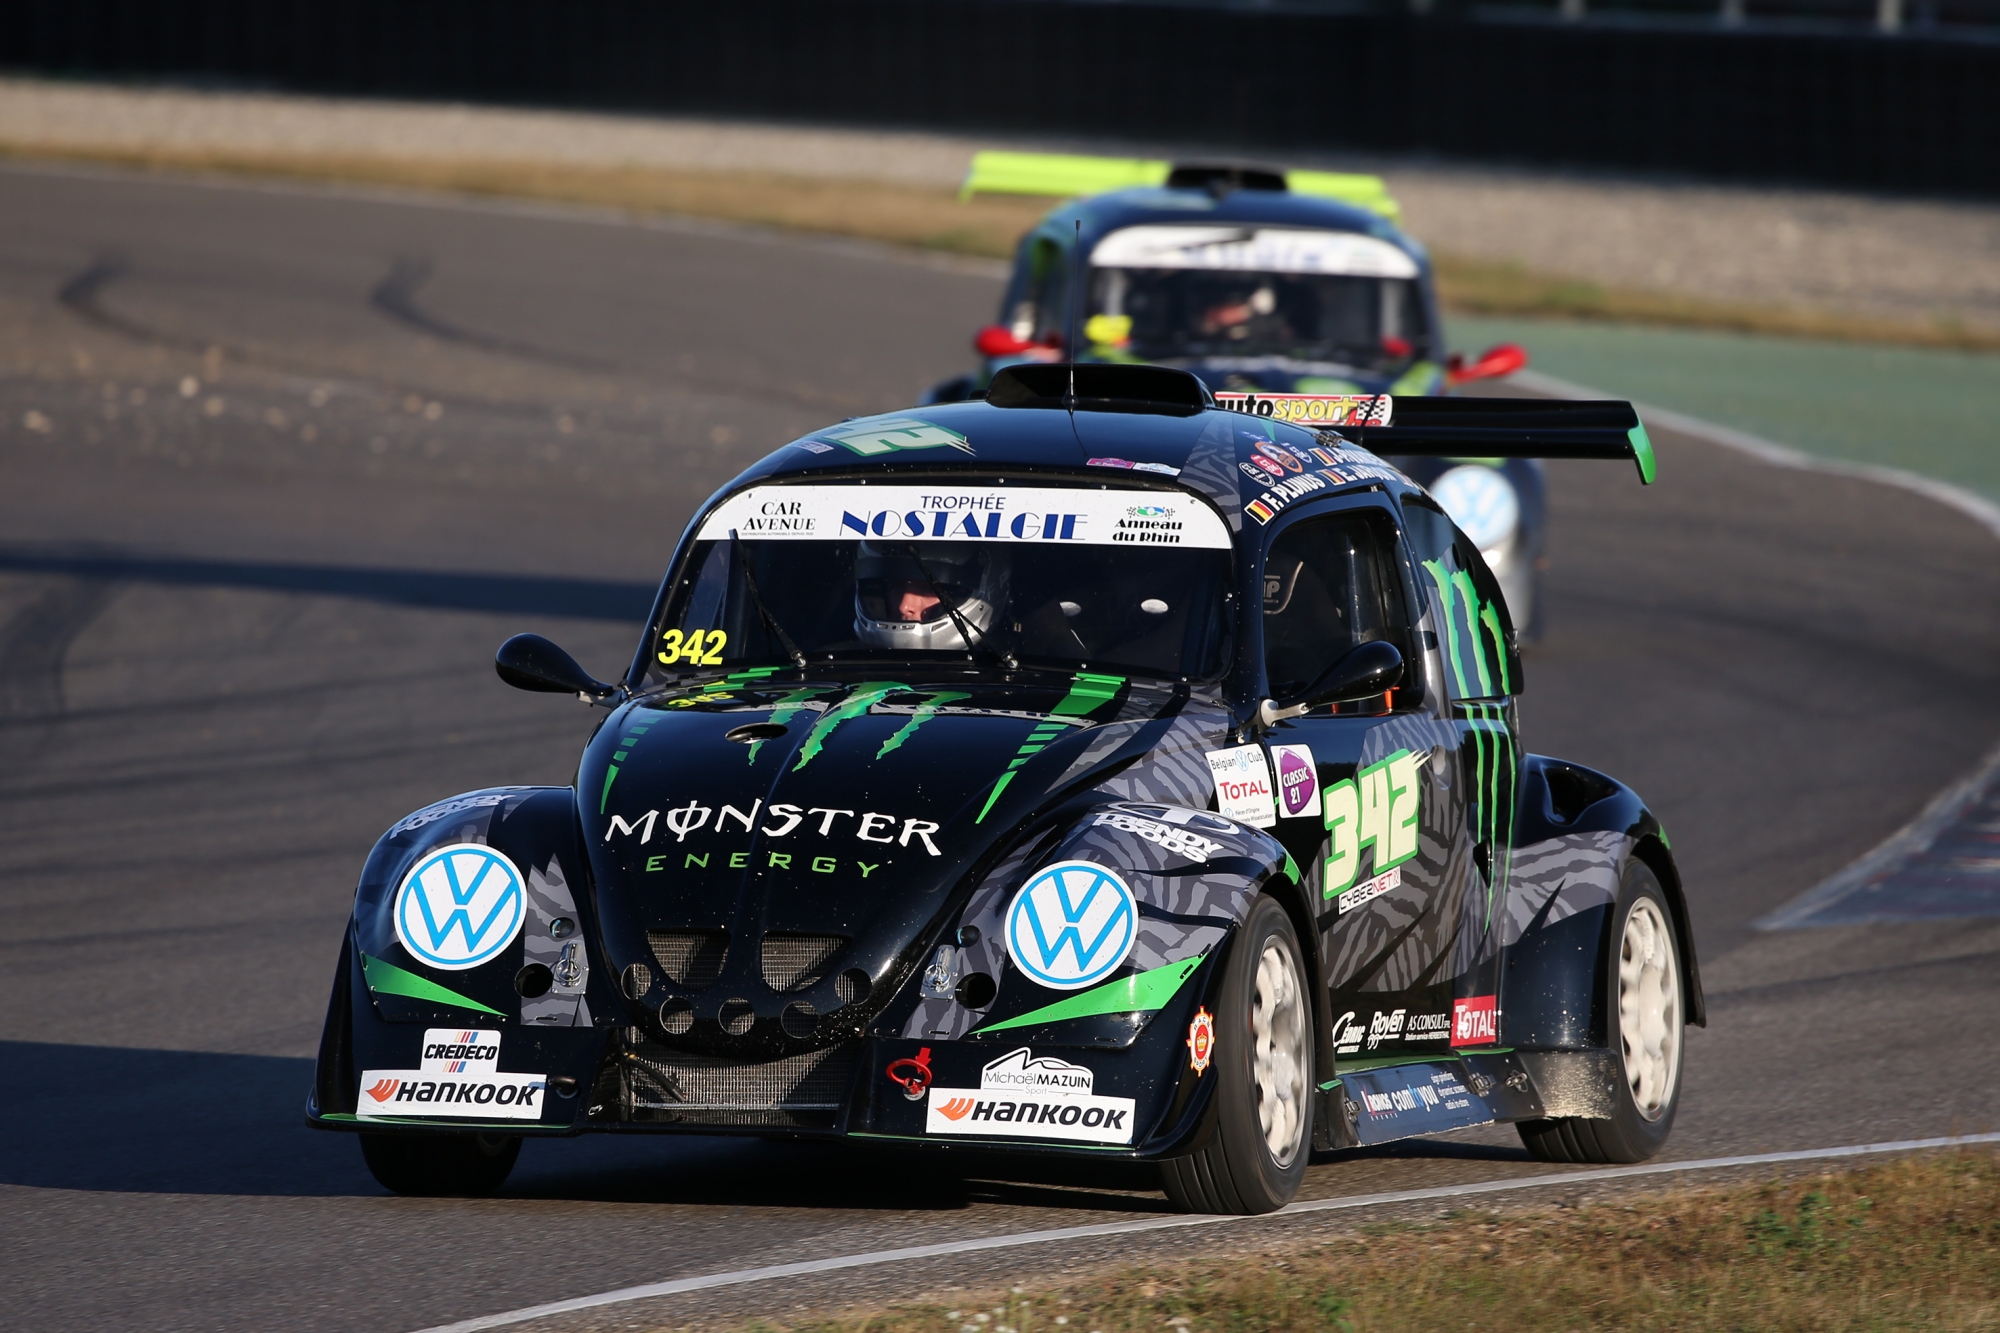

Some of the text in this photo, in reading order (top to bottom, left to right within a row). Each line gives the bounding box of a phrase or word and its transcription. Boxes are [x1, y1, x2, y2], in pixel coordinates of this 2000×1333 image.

[761, 501, 802, 516] CAR
[921, 493, 1006, 510] TROPHÉE
[743, 517, 816, 531] AVENUE
[839, 510, 1088, 540] NOSTALGIE
[1114, 518, 1182, 530] Anneau
[1112, 531, 1180, 543] du Rhin
[657, 629, 727, 665] 342
[1211, 758, 1237, 771] Belgian
[1247, 751, 1264, 763] Club
[1283, 767, 1309, 788] CLASSIC
[1219, 780, 1269, 800] TOTAL
[1290, 786, 1301, 805] 21
[1094, 813, 1224, 853] TRENDY
[1323, 748, 1424, 900] 342
[1092, 821, 1209, 863] FOODS
[646, 852, 879, 878] ENERGY
[1407, 1015, 1417, 1031] AS
[1417, 1013, 1446, 1030] CONSULT
[1455, 1004, 1496, 1040] TOTAL
[424, 1044, 498, 1060] CREDECO
[1025, 1086, 1047, 1096] Sport
